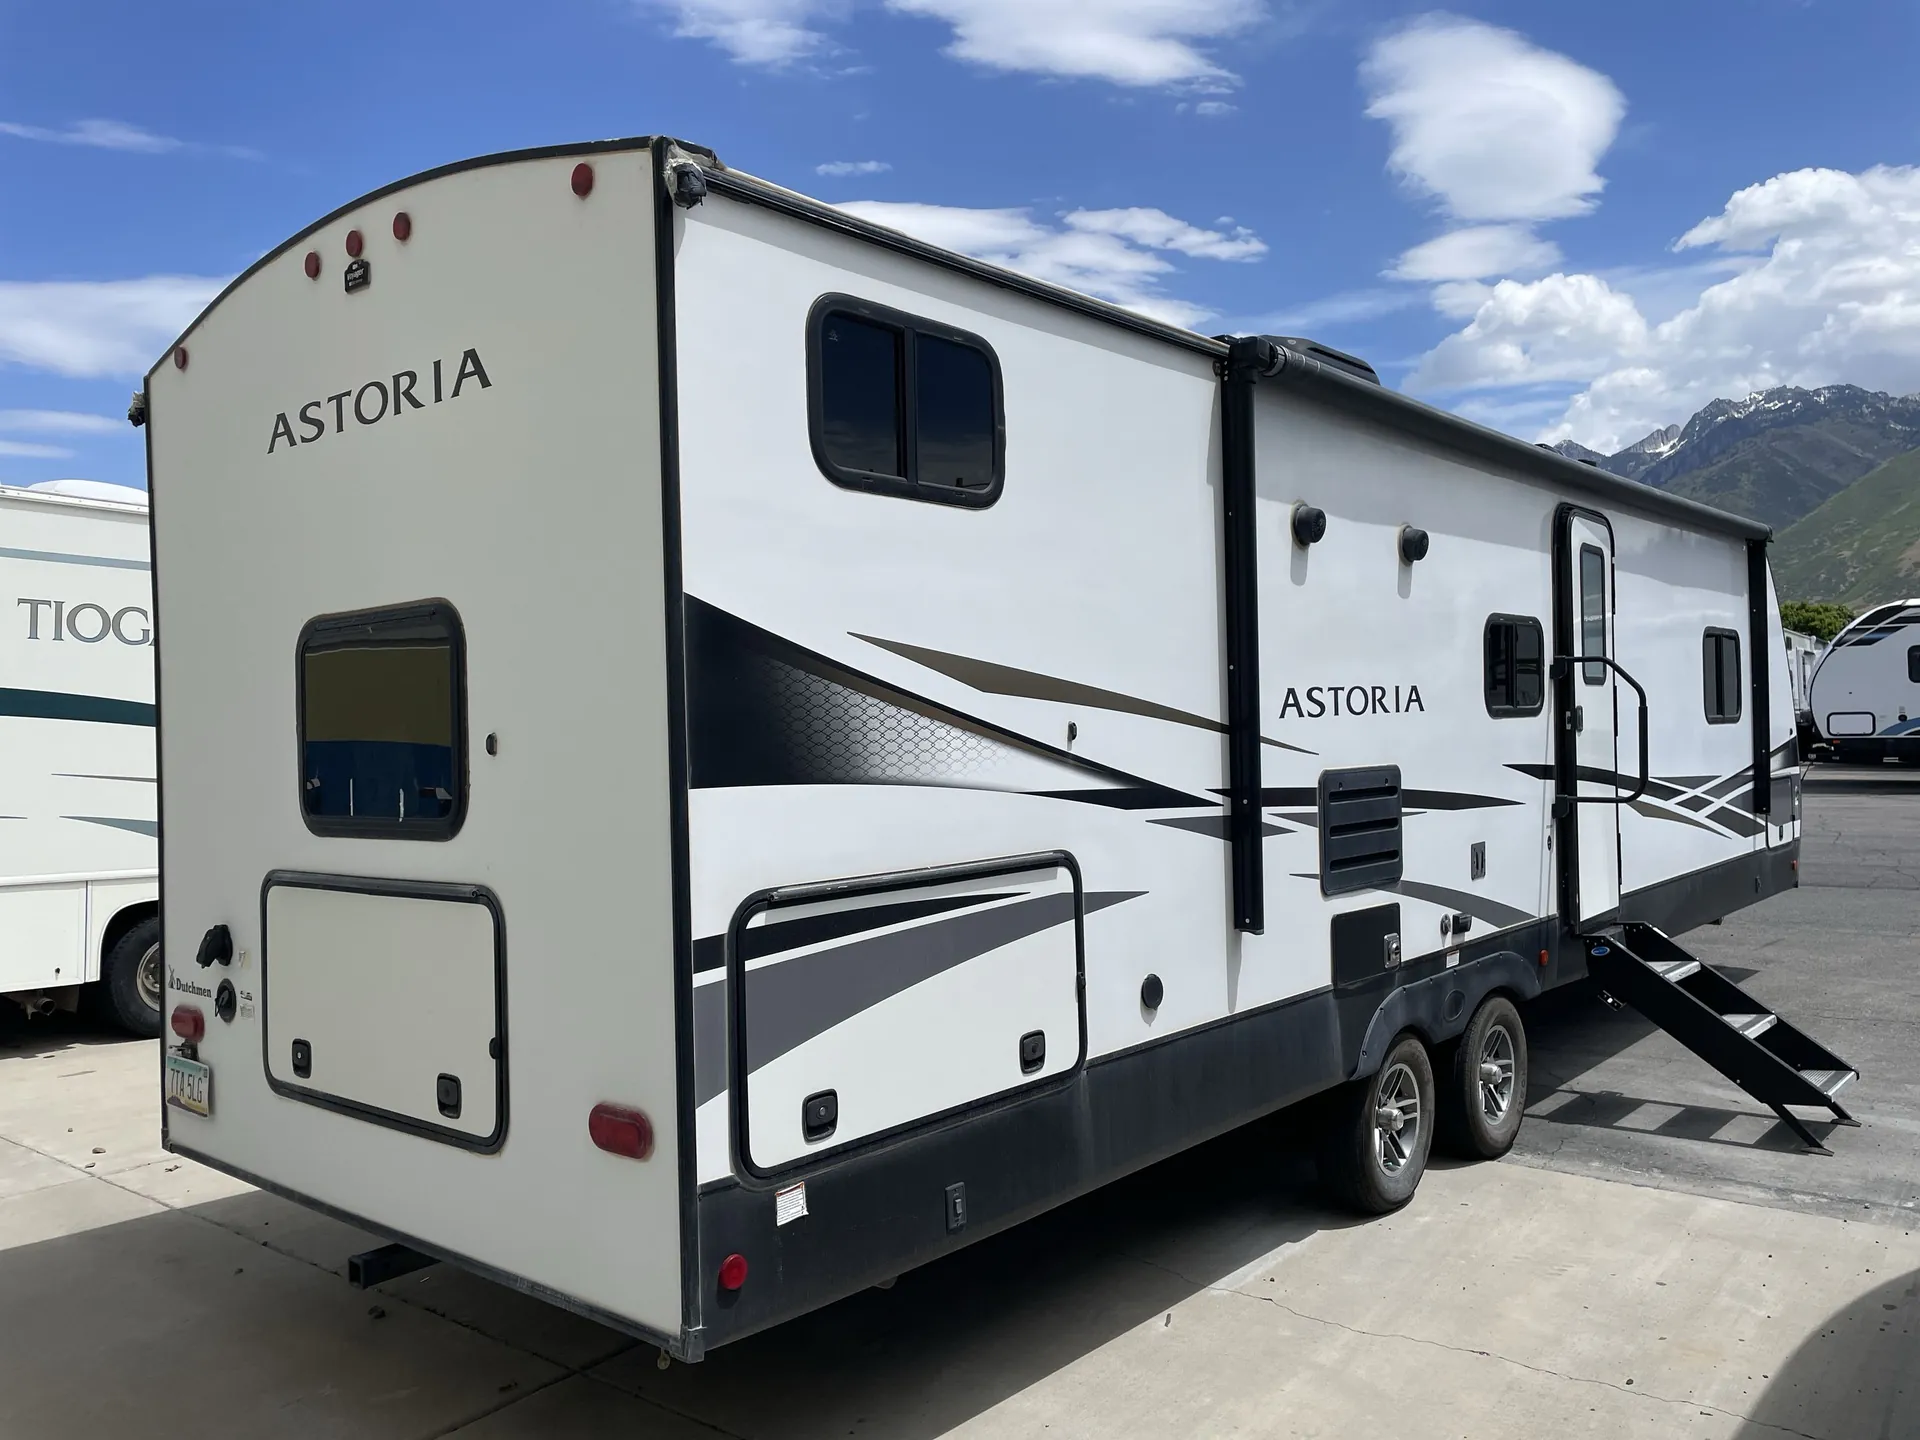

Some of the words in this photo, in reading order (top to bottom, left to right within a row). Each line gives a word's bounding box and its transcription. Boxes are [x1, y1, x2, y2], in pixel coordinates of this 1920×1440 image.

[267, 348, 492, 454] ASTORIA
[17, 597, 155, 647] TIOG
[1279, 685, 1425, 719] ASTORIA
[176, 978, 212, 998] Dutchmen
[170, 1068, 185, 1098] 7TA
[186, 1073, 203, 1104] 5LG
